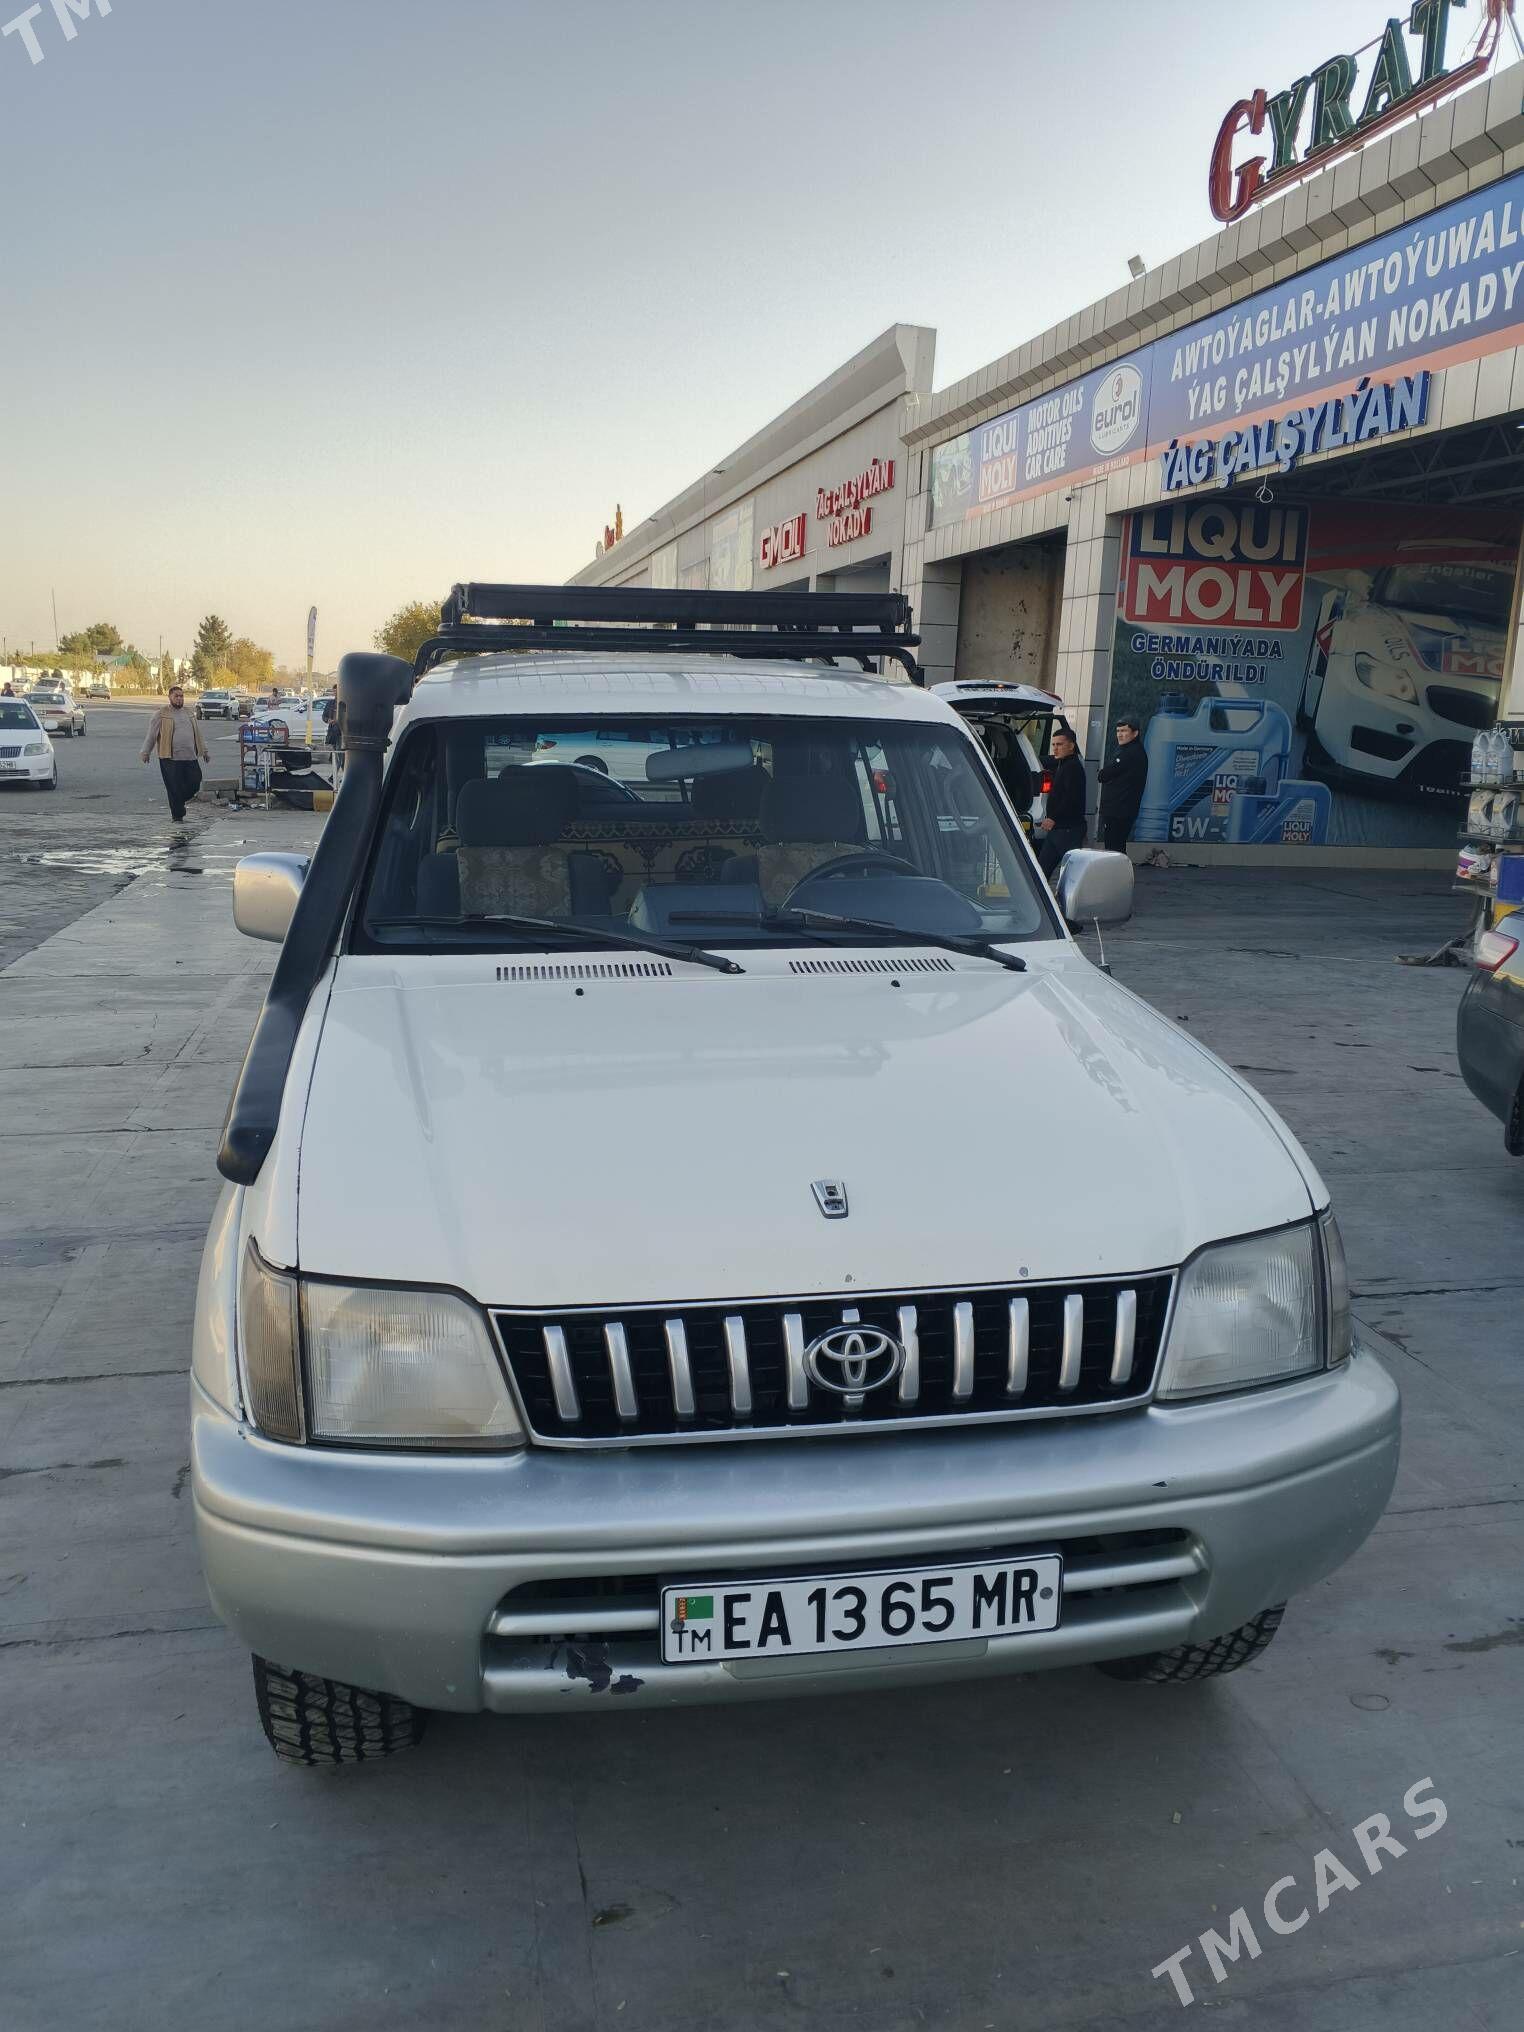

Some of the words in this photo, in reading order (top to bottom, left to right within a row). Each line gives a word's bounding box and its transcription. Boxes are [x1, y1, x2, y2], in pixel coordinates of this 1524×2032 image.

[1171, 200, 1524, 382] AWTOÝAGLAR-AWTOÝUWAL
[1188, 378, 1226, 421] ÝAG
[1234, 318, 1377, 415] ÇALŞYLÝAN
[1387, 264, 1522, 351] NOKADY
[1028, 399, 1060, 431] MOTOR
[1062, 386, 1084, 418] OILS
[1095, 391, 1137, 431] eurol
[982, 419, 1017, 462] LIQUI
[1026, 418, 1073, 457] ADDITIVES
[1161, 436, 1213, 491] ÝAG
[1216, 370, 1430, 488] ÇALŞYLÝAN
[981, 455, 1016, 497] MOLY
[1026, 456, 1042, 480] CAR
[1044, 445, 1066, 474] CARE
[827, 507, 873, 547] NOKADY
[1140, 504, 1299, 561] LIQUI
[1135, 565, 1300, 622] MOLY
[1131, 633, 1284, 659] GERMANIÝADA
[1151, 659, 1267, 684] ÖNDÜRILDI
[1216, 775, 1238, 789] LIQ
[1283, 831, 1312, 841] MOLY
[1284, 822, 1312, 831] LIQUI
[723, 1592, 791, 1650] EA
[807, 1577, 954, 1643] 1365
[972, 1568, 1039, 1630] MR
[672, 1628, 711, 1654] TM
